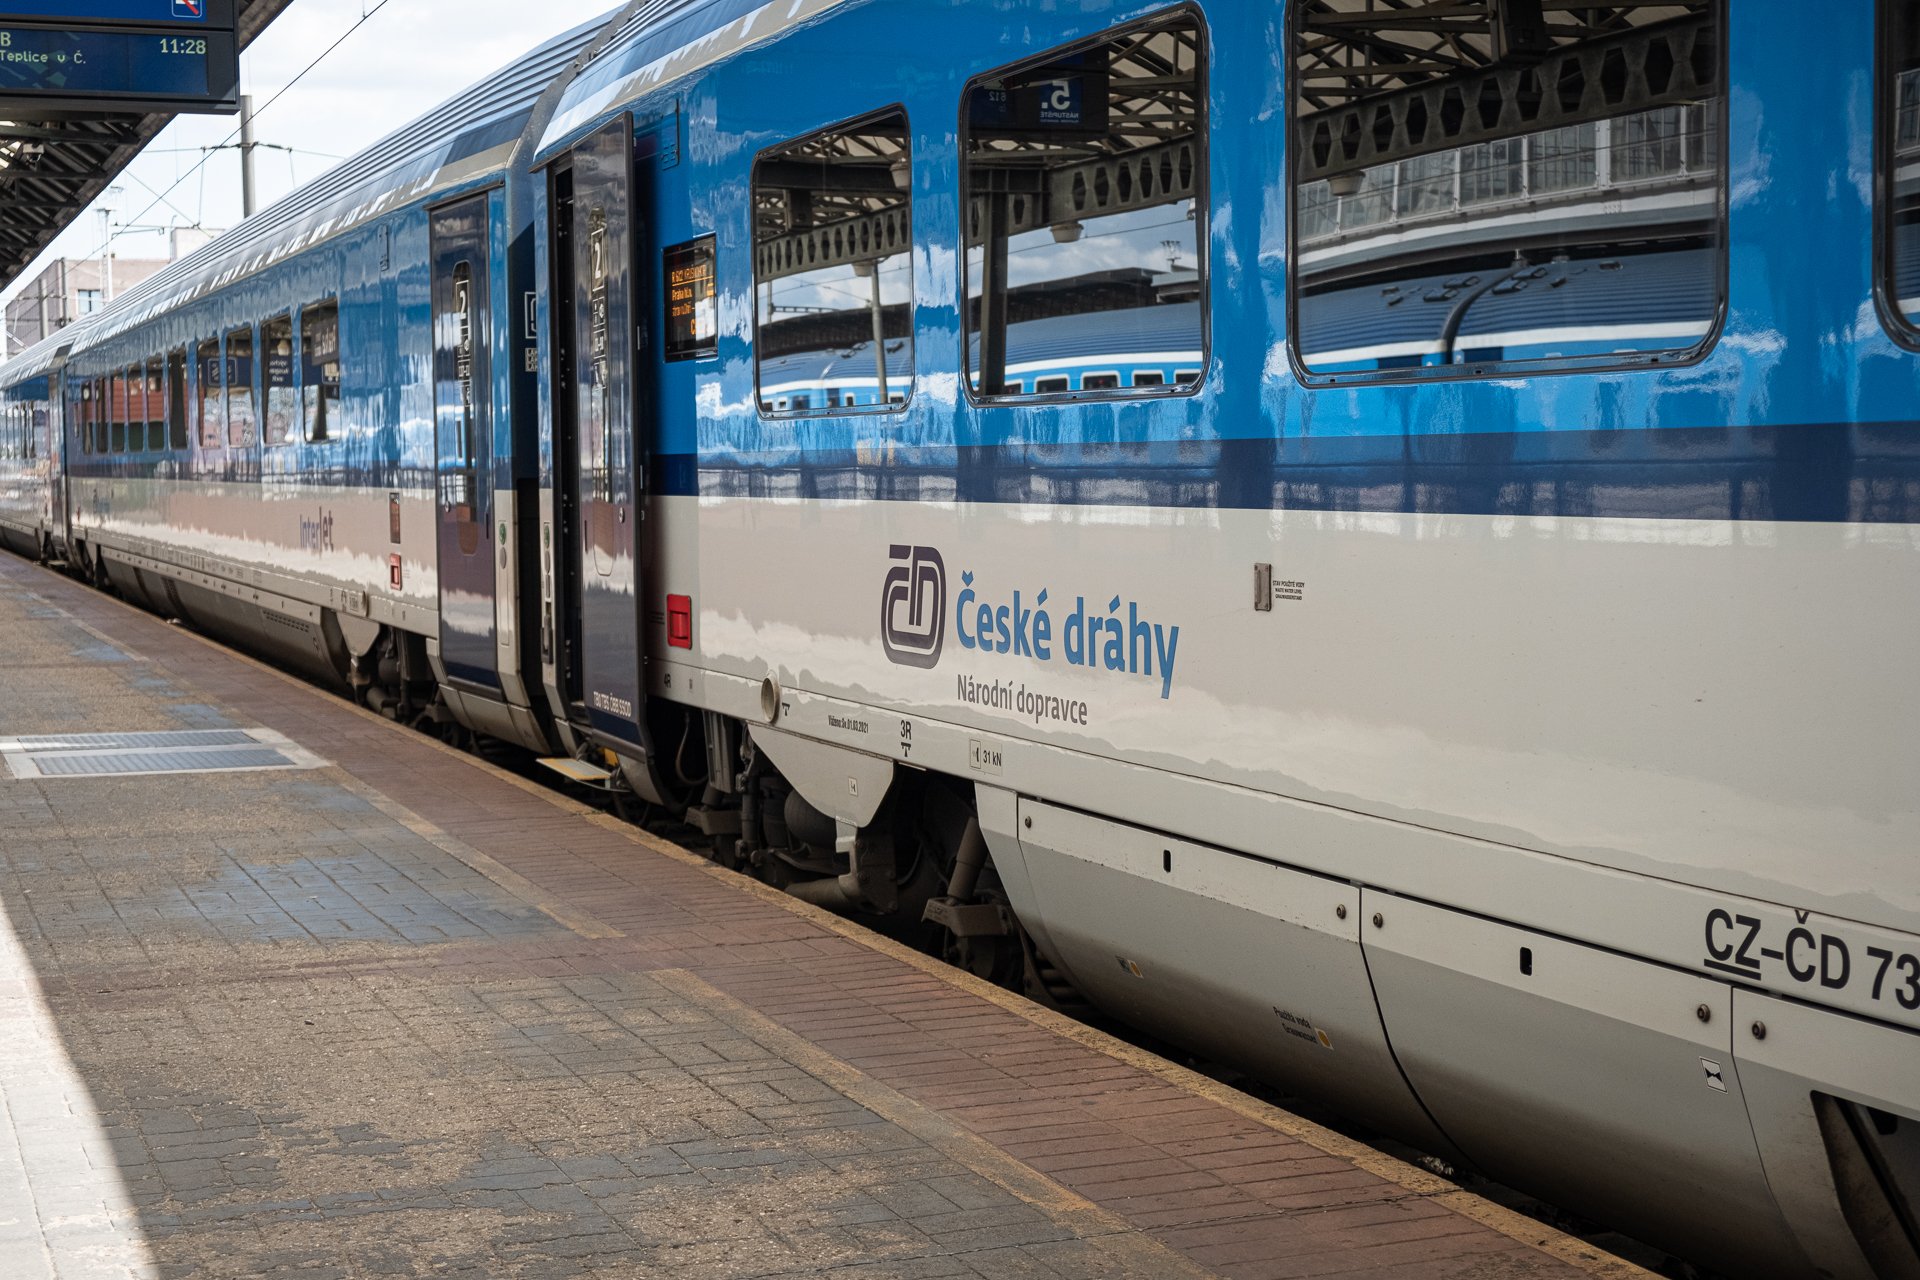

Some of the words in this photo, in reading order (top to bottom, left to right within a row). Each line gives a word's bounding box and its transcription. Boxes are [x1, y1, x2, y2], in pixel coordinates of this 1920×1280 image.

[0, 50, 48, 63] Teplice
[73, 50, 86, 64] Č.
[160, 38, 206, 54] 11:28
[594, 242, 602, 279] 2
[459, 290, 467, 320] 2
[956, 570, 1051, 660] České
[1063, 594, 1180, 699] dráhy
[957, 674, 1013, 711] Národní
[1016, 684, 1088, 725] dopravce
[900, 719, 912, 741] 3R
[983, 751, 992, 764] 31
[992, 752, 1002, 767] kN
[1704, 909, 1850, 989] CZ-ČD
[1866, 946, 1920, 1010] 73
